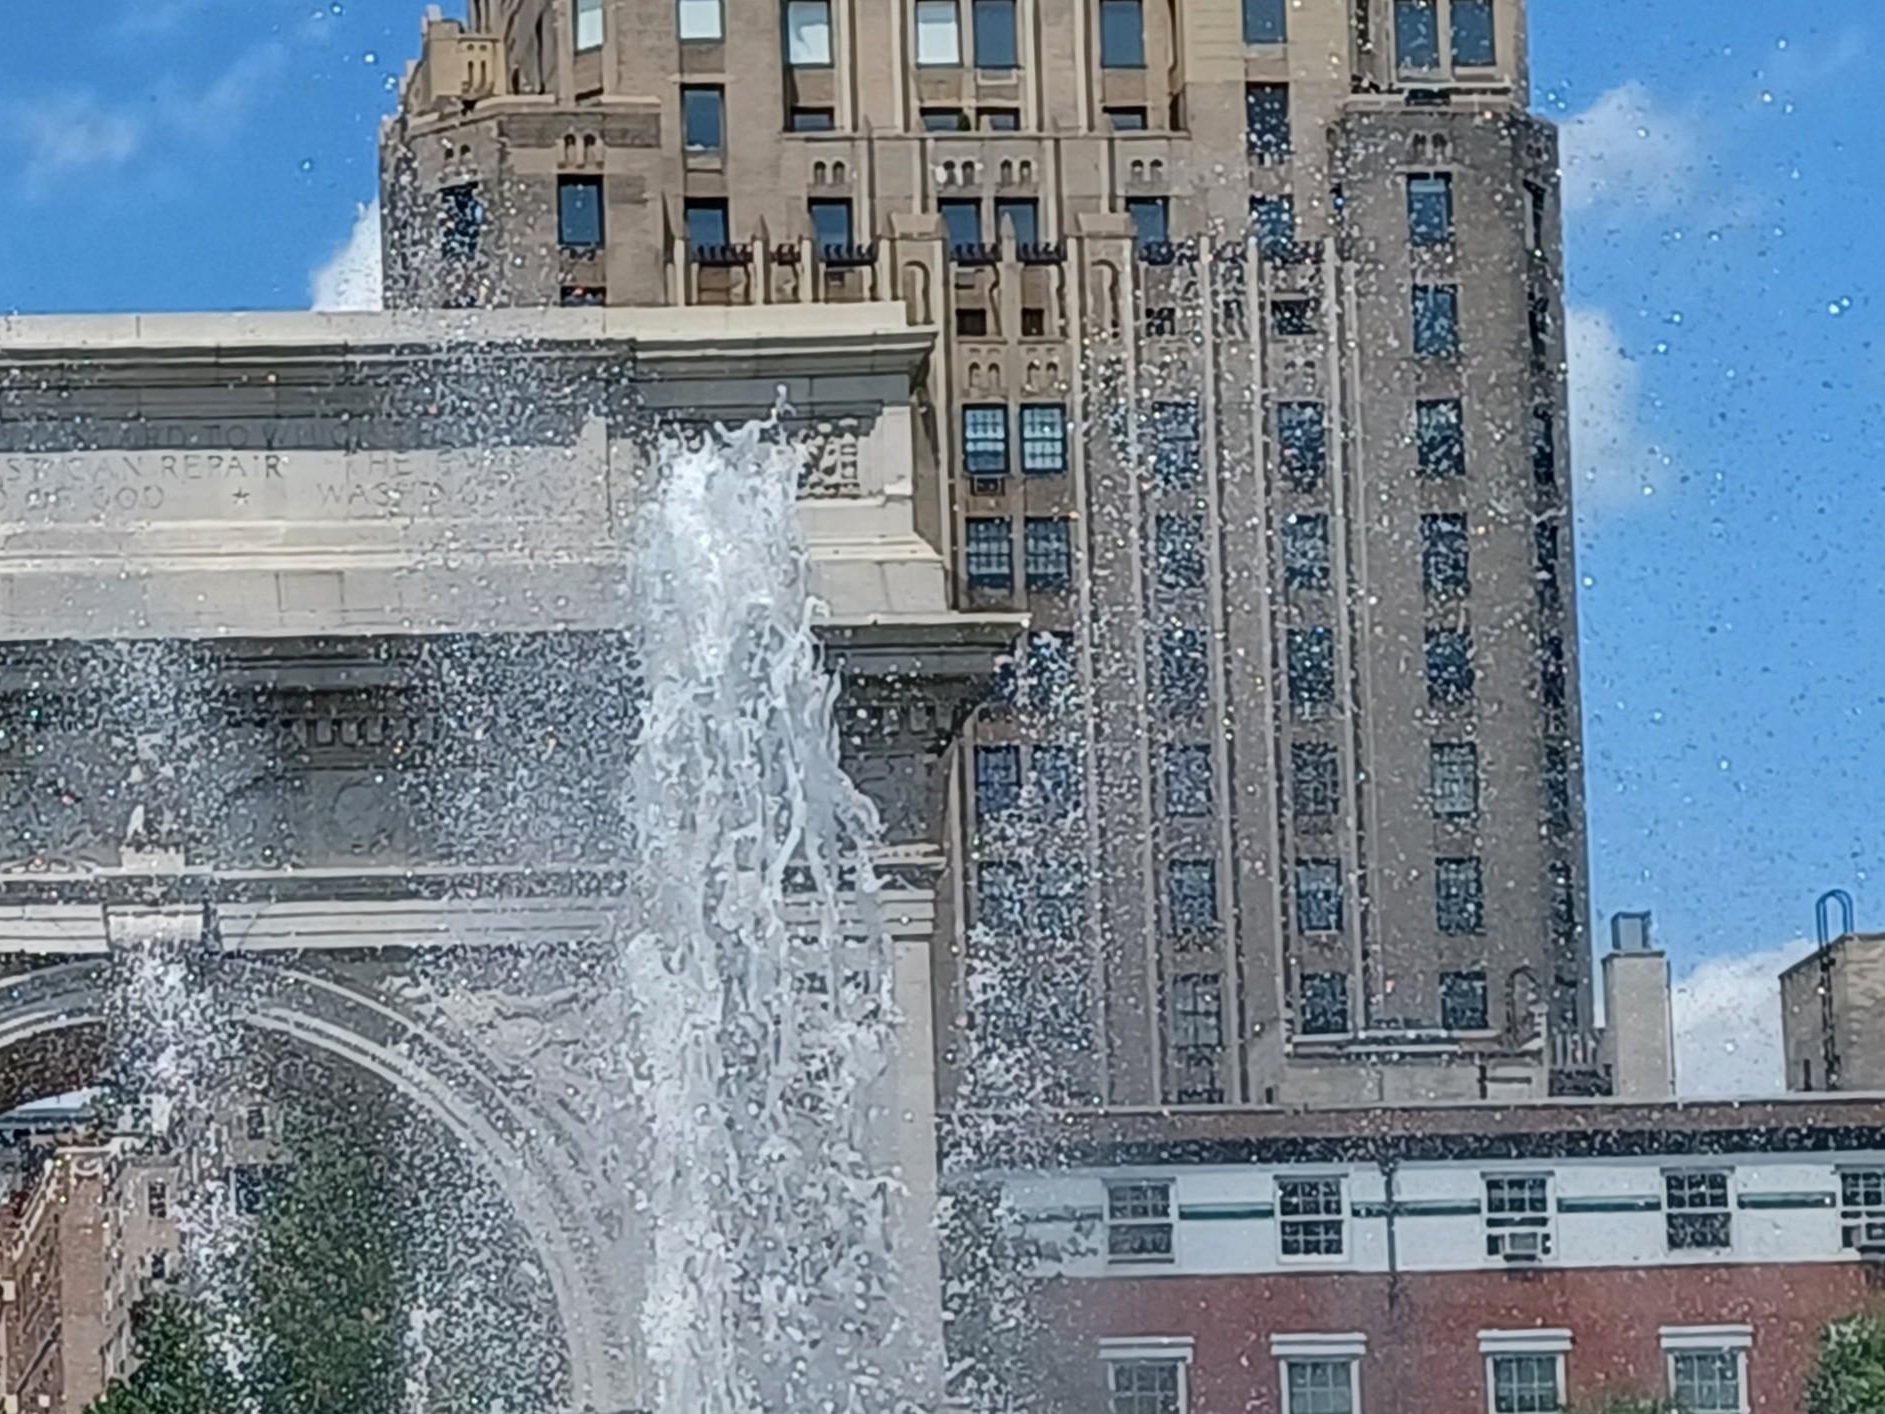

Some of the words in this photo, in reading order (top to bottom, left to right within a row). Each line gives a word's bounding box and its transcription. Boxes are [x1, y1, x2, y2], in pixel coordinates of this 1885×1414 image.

[203, 424, 247, 447] TO
[66, 455, 142, 482] CAN
[160, 454, 284, 479] REPAIR
[323, 451, 413, 477] THE
[89, 485, 164, 510] GOD
